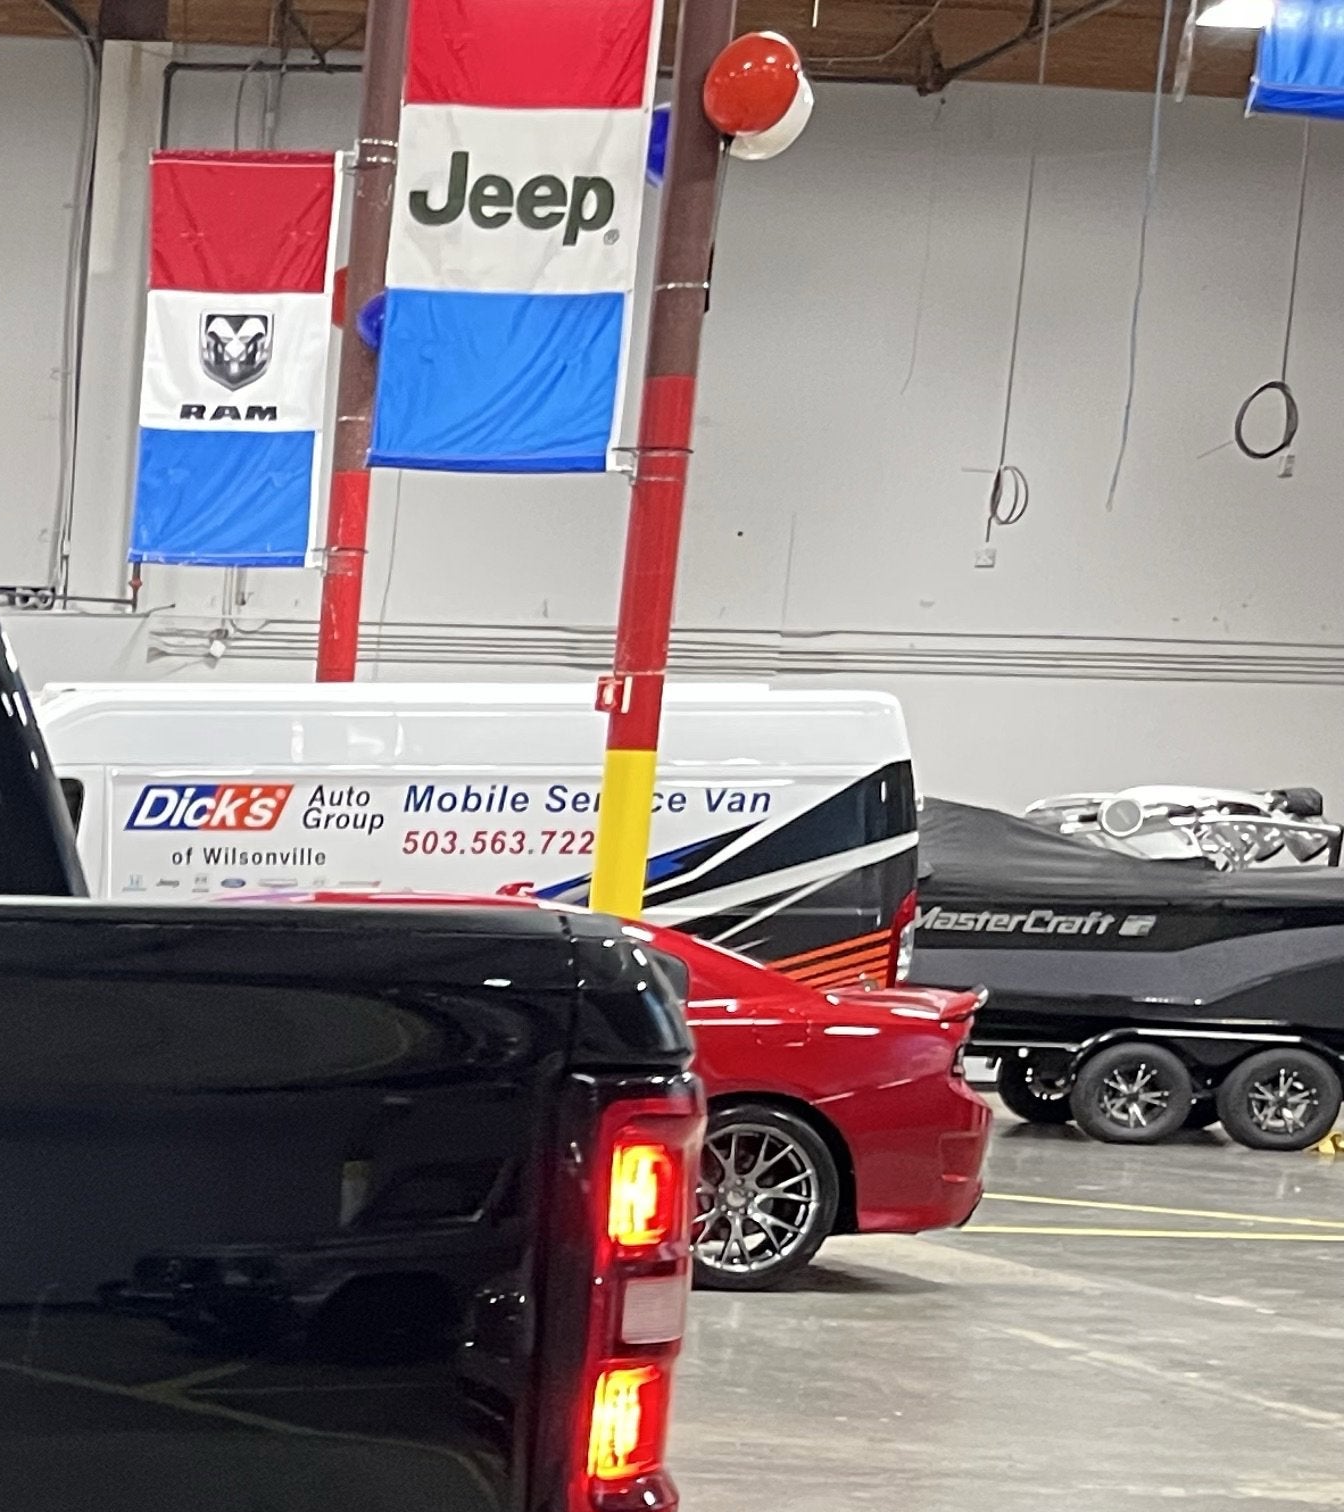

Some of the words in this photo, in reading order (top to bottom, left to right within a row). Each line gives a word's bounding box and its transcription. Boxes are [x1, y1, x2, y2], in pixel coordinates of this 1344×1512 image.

[409, 151, 615, 245] Jeep
[180, 404, 277, 421] RAM
[134, 788, 276, 830] Dick's
[309, 784, 372, 807] Auto
[403, 784, 530, 813] Mobile
[706, 787, 771, 813] Van
[301, 806, 385, 836] Group
[172, 847, 192, 866] of
[202, 847, 326, 867] Wilsonville
[914, 906, 1116, 936] MasterCraft
